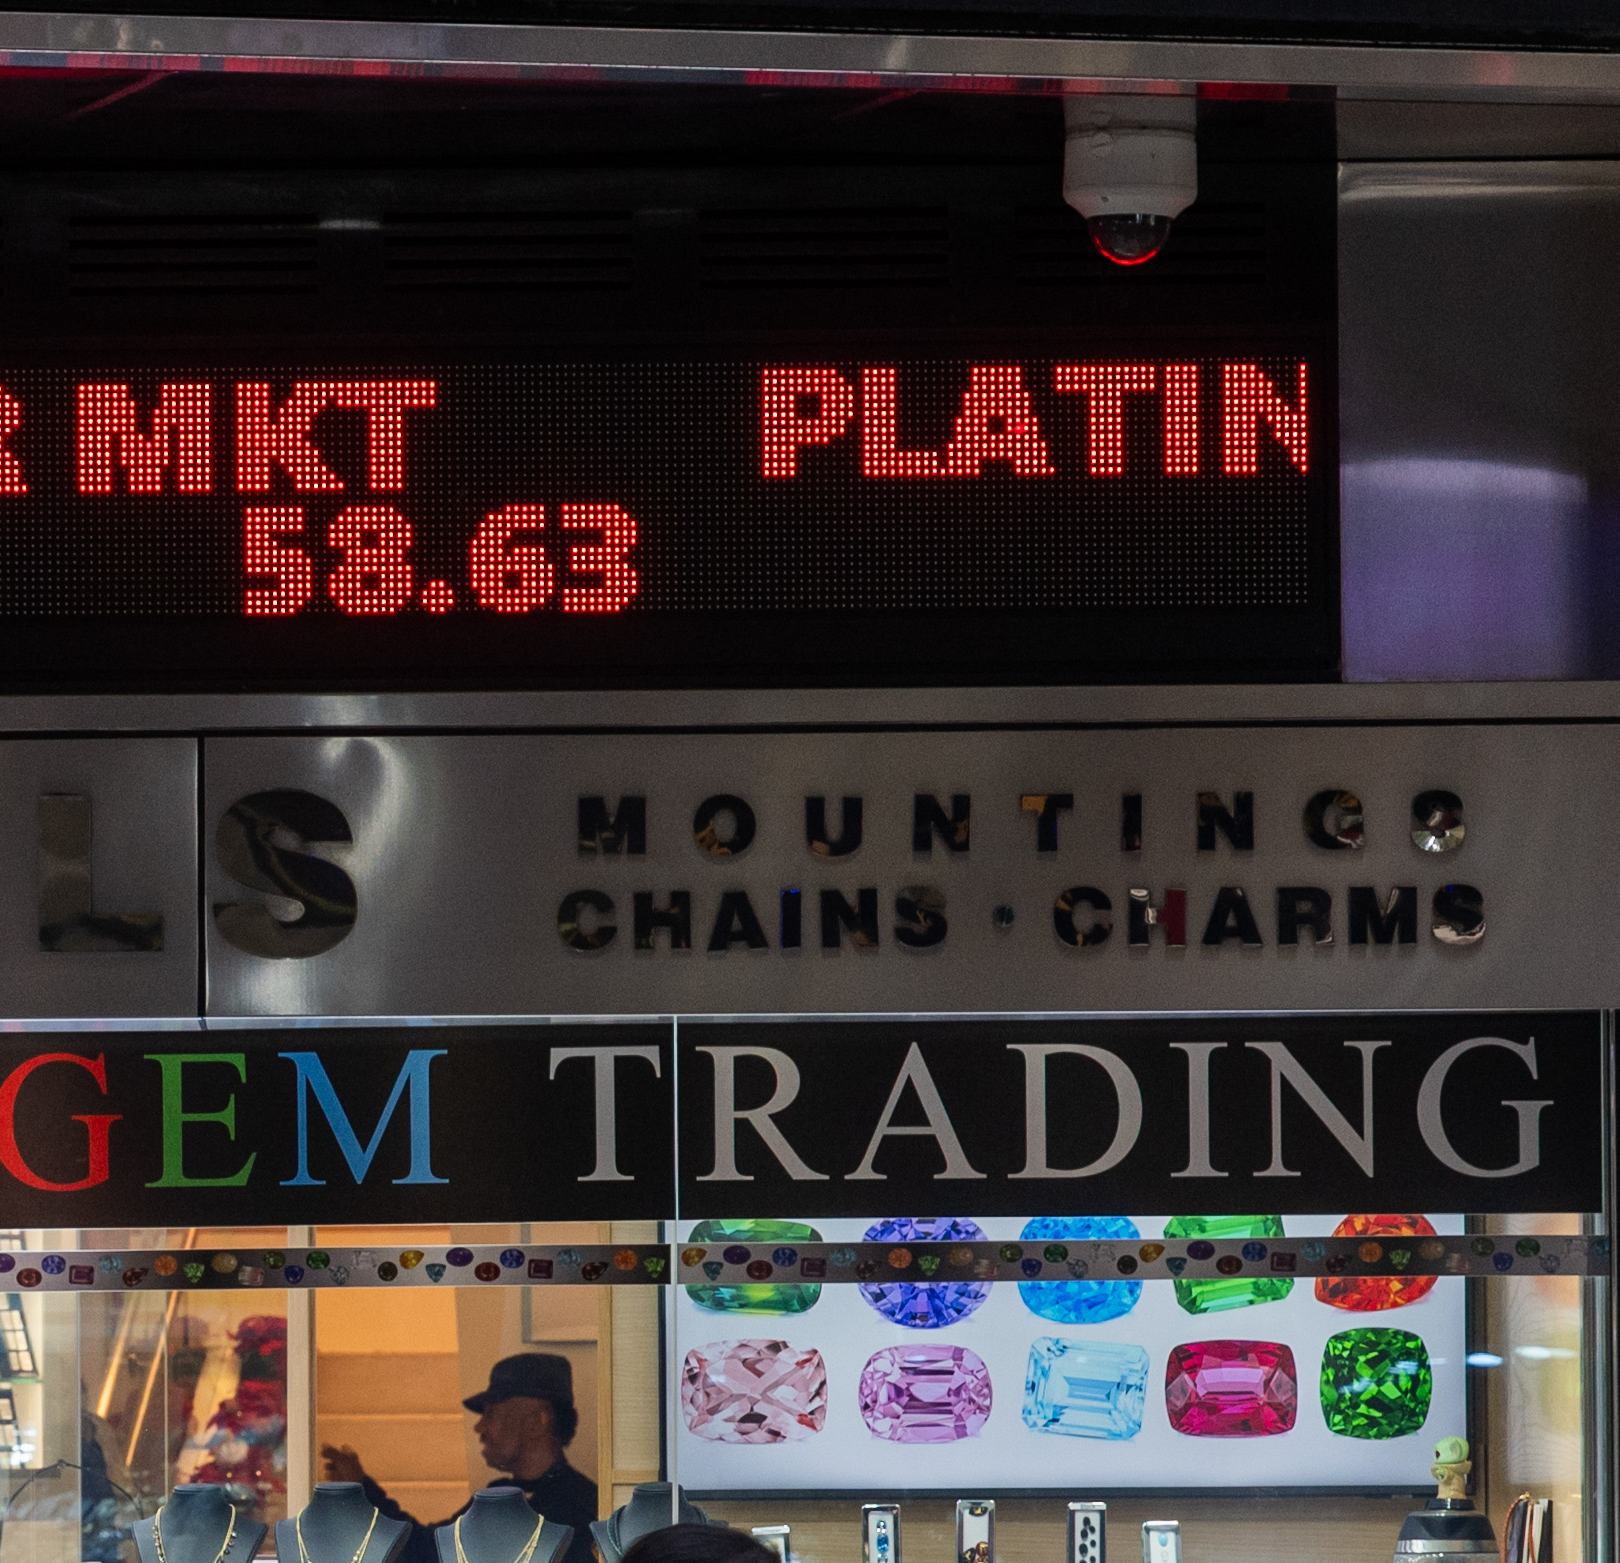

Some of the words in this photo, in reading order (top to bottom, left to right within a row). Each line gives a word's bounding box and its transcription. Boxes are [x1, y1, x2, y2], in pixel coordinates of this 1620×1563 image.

[75, 381, 437, 496] MKT
[760, 364, 1310, 480] PLATIN
[243, 502, 641, 616] 58.63
[575, 789, 1468, 858] MOUNTINGS
[559, 886, 950, 953] CHAINS
[1053, 884, 1488, 949] CHARMS
[548, 1035, 1555, 1182] TRADING
